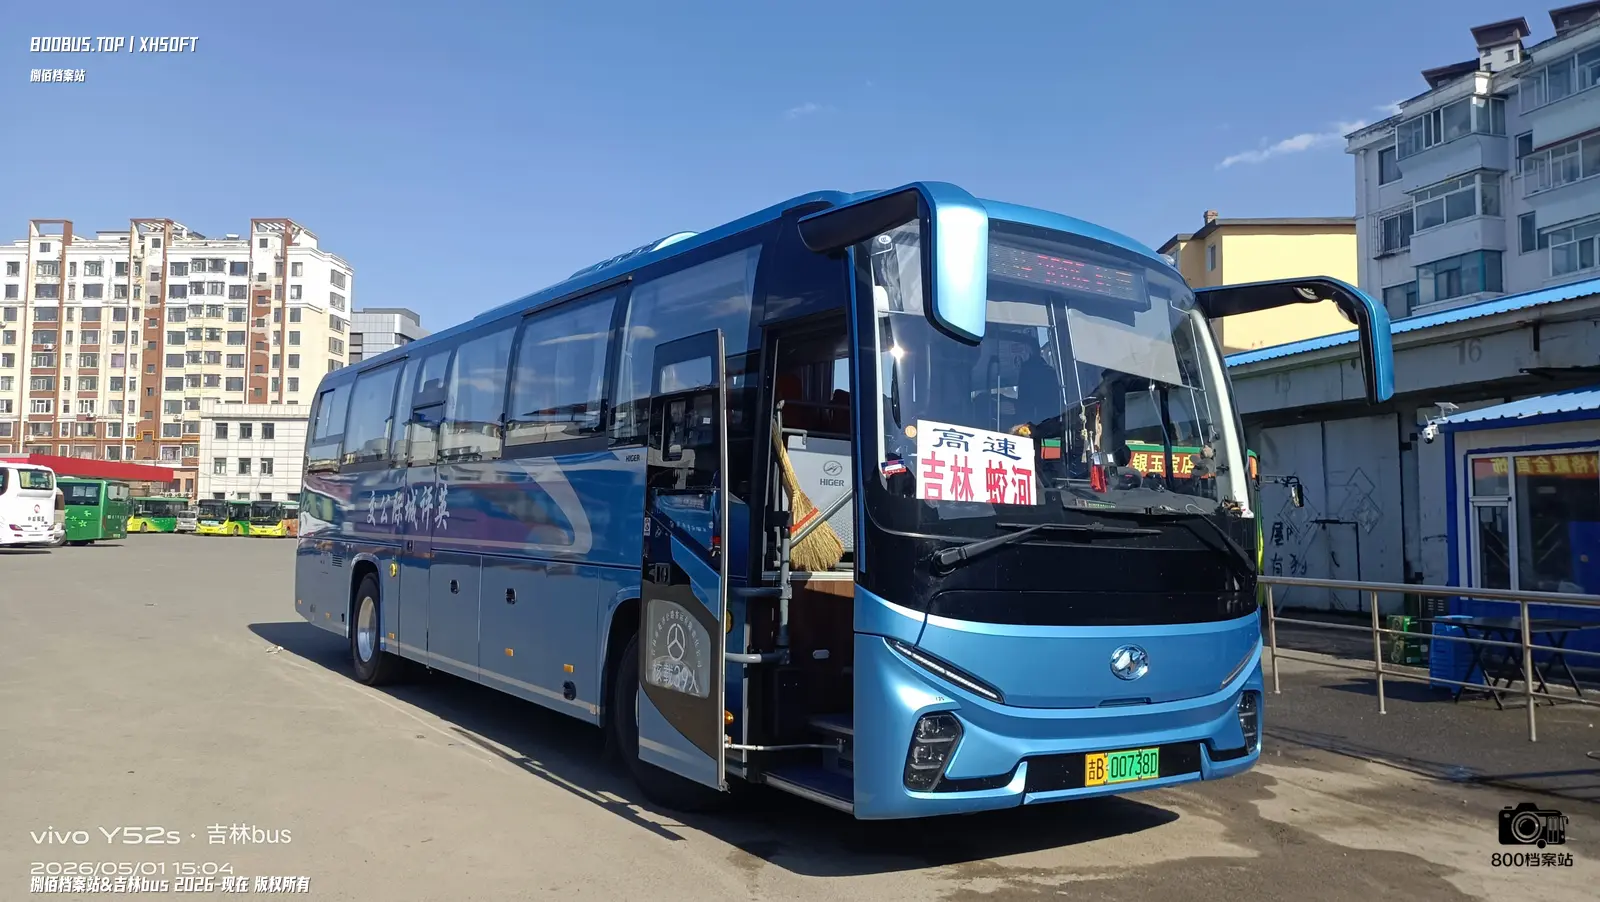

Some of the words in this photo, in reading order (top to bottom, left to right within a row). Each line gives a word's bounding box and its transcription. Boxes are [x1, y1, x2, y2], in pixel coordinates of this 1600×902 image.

[1452, 340, 1482, 366] 16
[932, 427, 1022, 461] 高速
[625, 454, 640, 463] HIGER
[819, 478, 845, 487] HIGER
[921, 450, 975, 502] 吉林
[985, 459, 1032, 505] 蛟河
[1088, 758, 1105, 780] 吉B
[1111, 752, 1157, 778] 00738D
